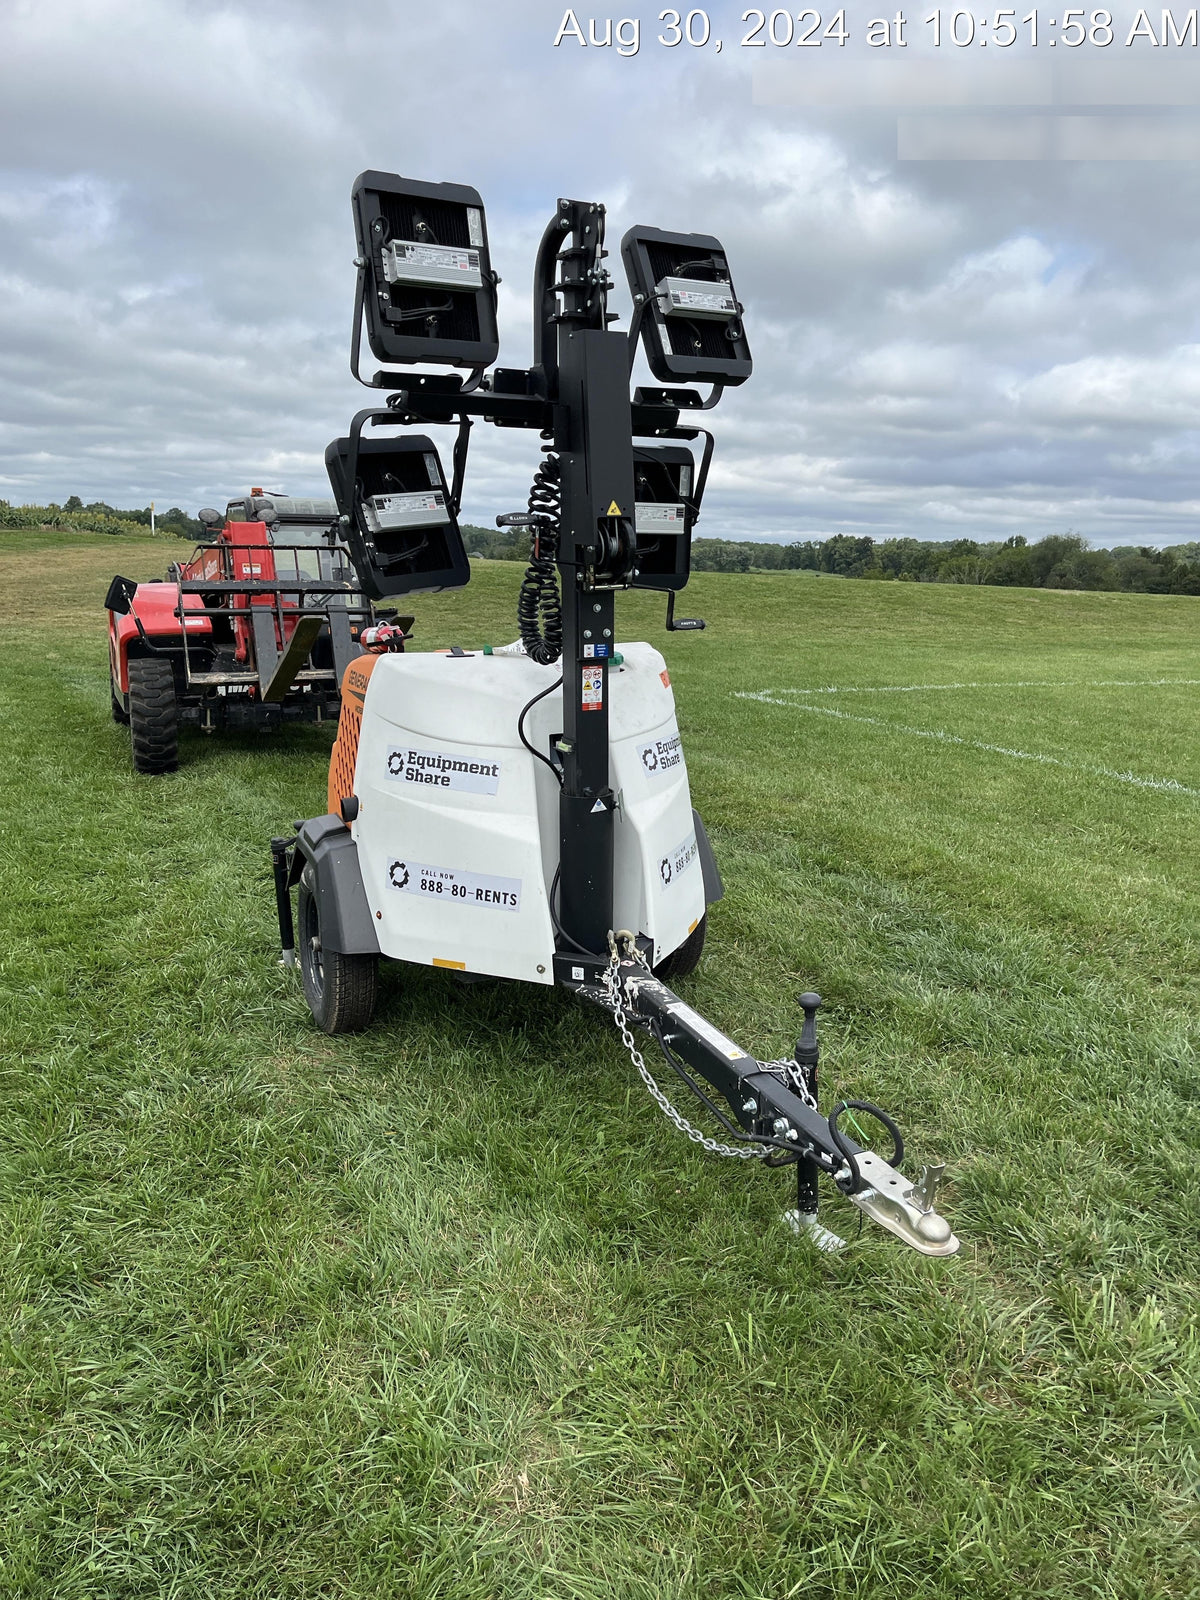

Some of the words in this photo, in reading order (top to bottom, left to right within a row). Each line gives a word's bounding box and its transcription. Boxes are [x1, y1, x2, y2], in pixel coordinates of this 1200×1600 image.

[655, 737, 681, 755] Equip
[407, 750, 499, 777] Equipment
[405, 767, 451, 786] Share
[421, 869, 437, 878] CALL
[440, 872, 455, 880] NOW
[420, 878, 518, 906] 888-80-RENTS
